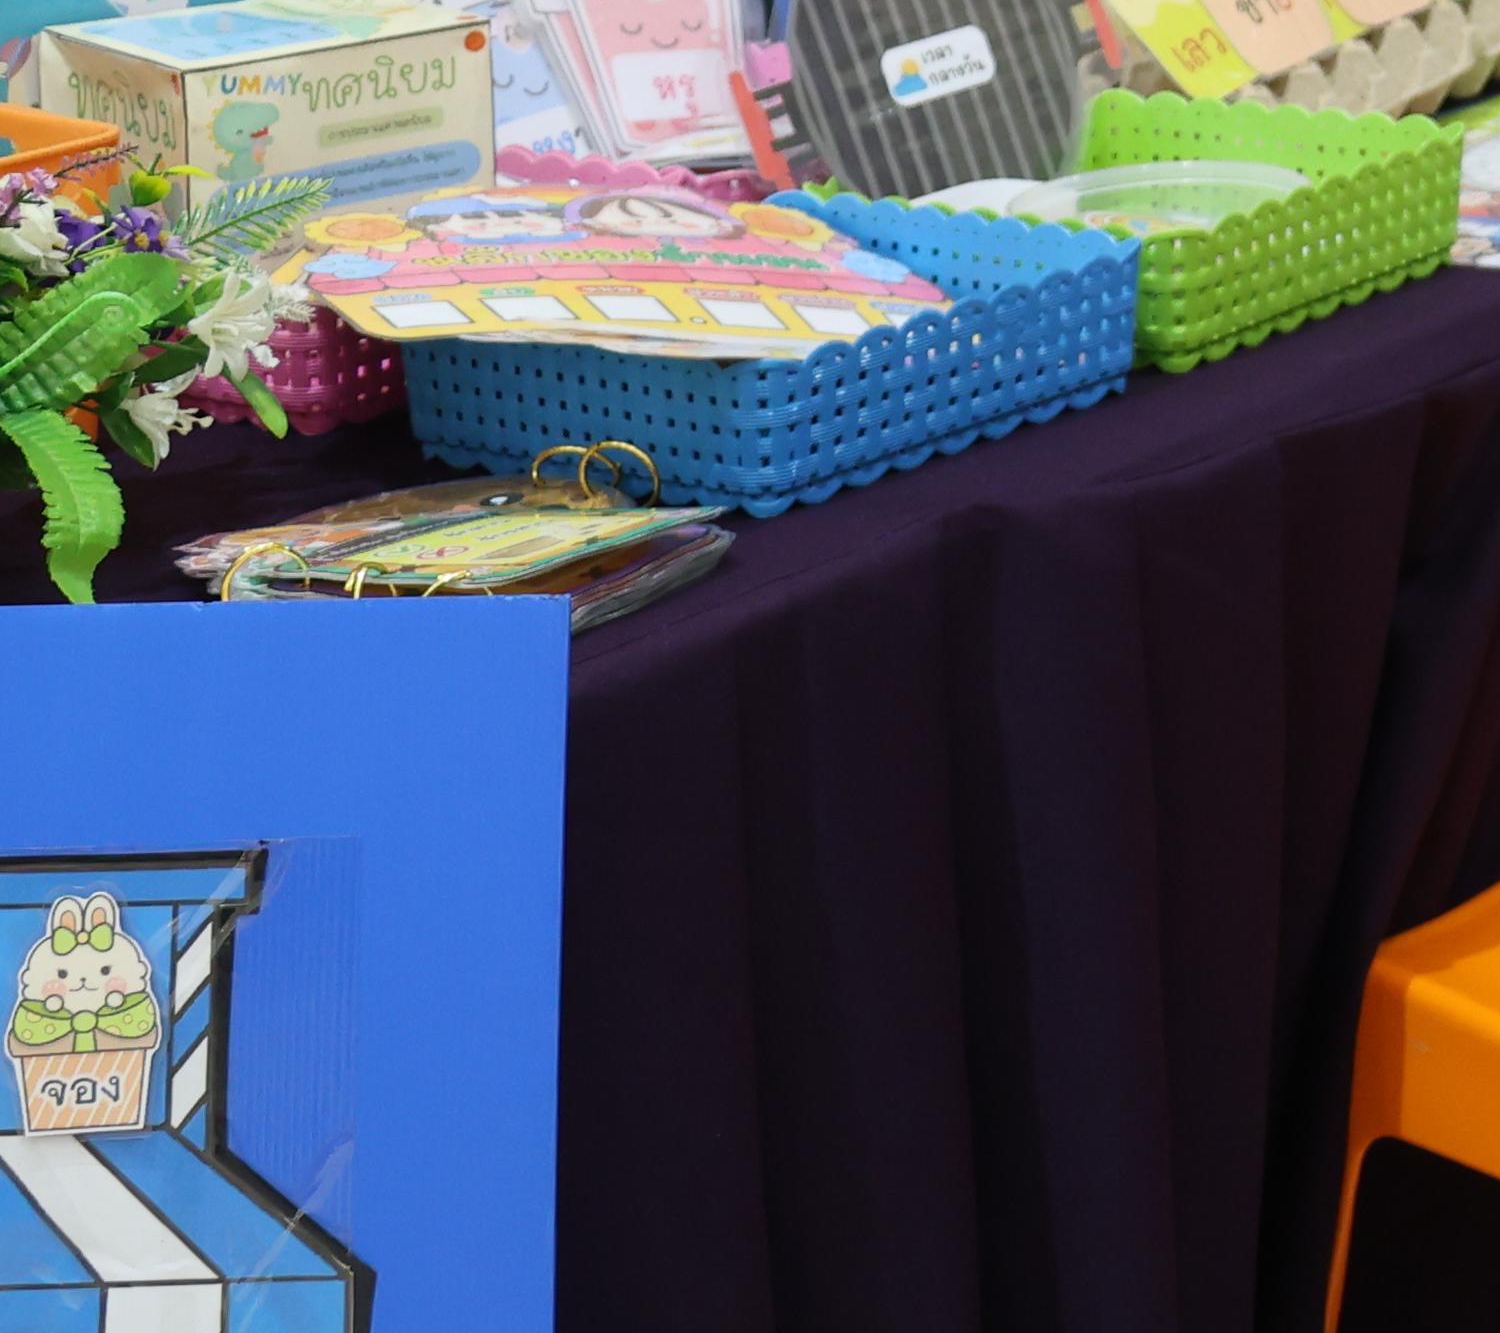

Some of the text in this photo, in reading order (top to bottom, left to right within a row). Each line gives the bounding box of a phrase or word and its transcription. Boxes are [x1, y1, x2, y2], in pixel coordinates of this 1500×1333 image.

[203, 54, 457, 112] YUMMY ทศนิยม
[928, 53, 987, 86] กลางวัน
[40, 1074, 122, 1108] จอง
